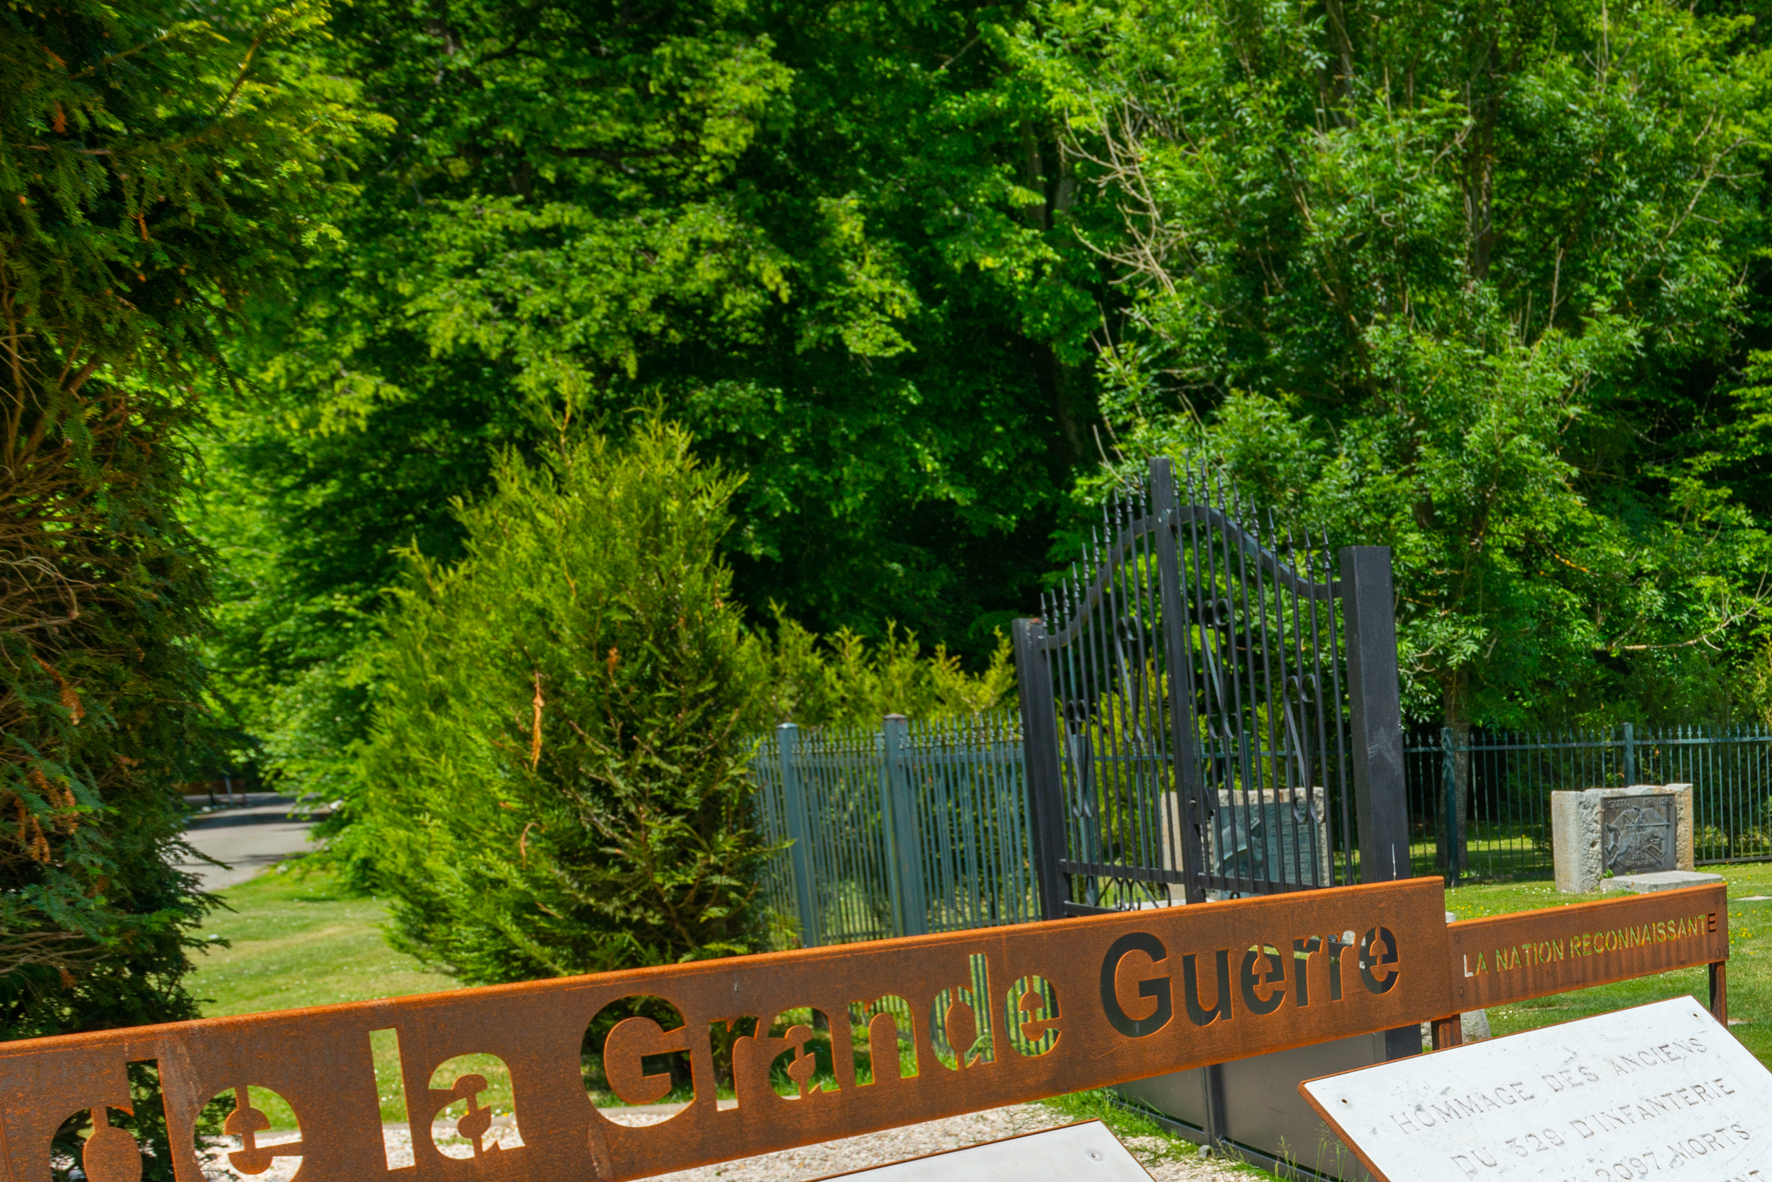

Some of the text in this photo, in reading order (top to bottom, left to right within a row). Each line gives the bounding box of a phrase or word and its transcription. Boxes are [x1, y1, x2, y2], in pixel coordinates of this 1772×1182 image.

[1463, 912, 1717, 978] LA NATION RECONNAISSANTE
[369, 1027, 525, 1171] la
[579, 952, 1063, 1128] Grande
[1099, 926, 1401, 1039] Guerre
[1389, 1036, 1708, 1133] HOMMAGE DES ANCIENS
[1451, 1147, 1501, 1175] DU
[1570, 1077, 1735, 1139] D'INFANTERIE
[1667, 1122, 1752, 1162] MORTS
